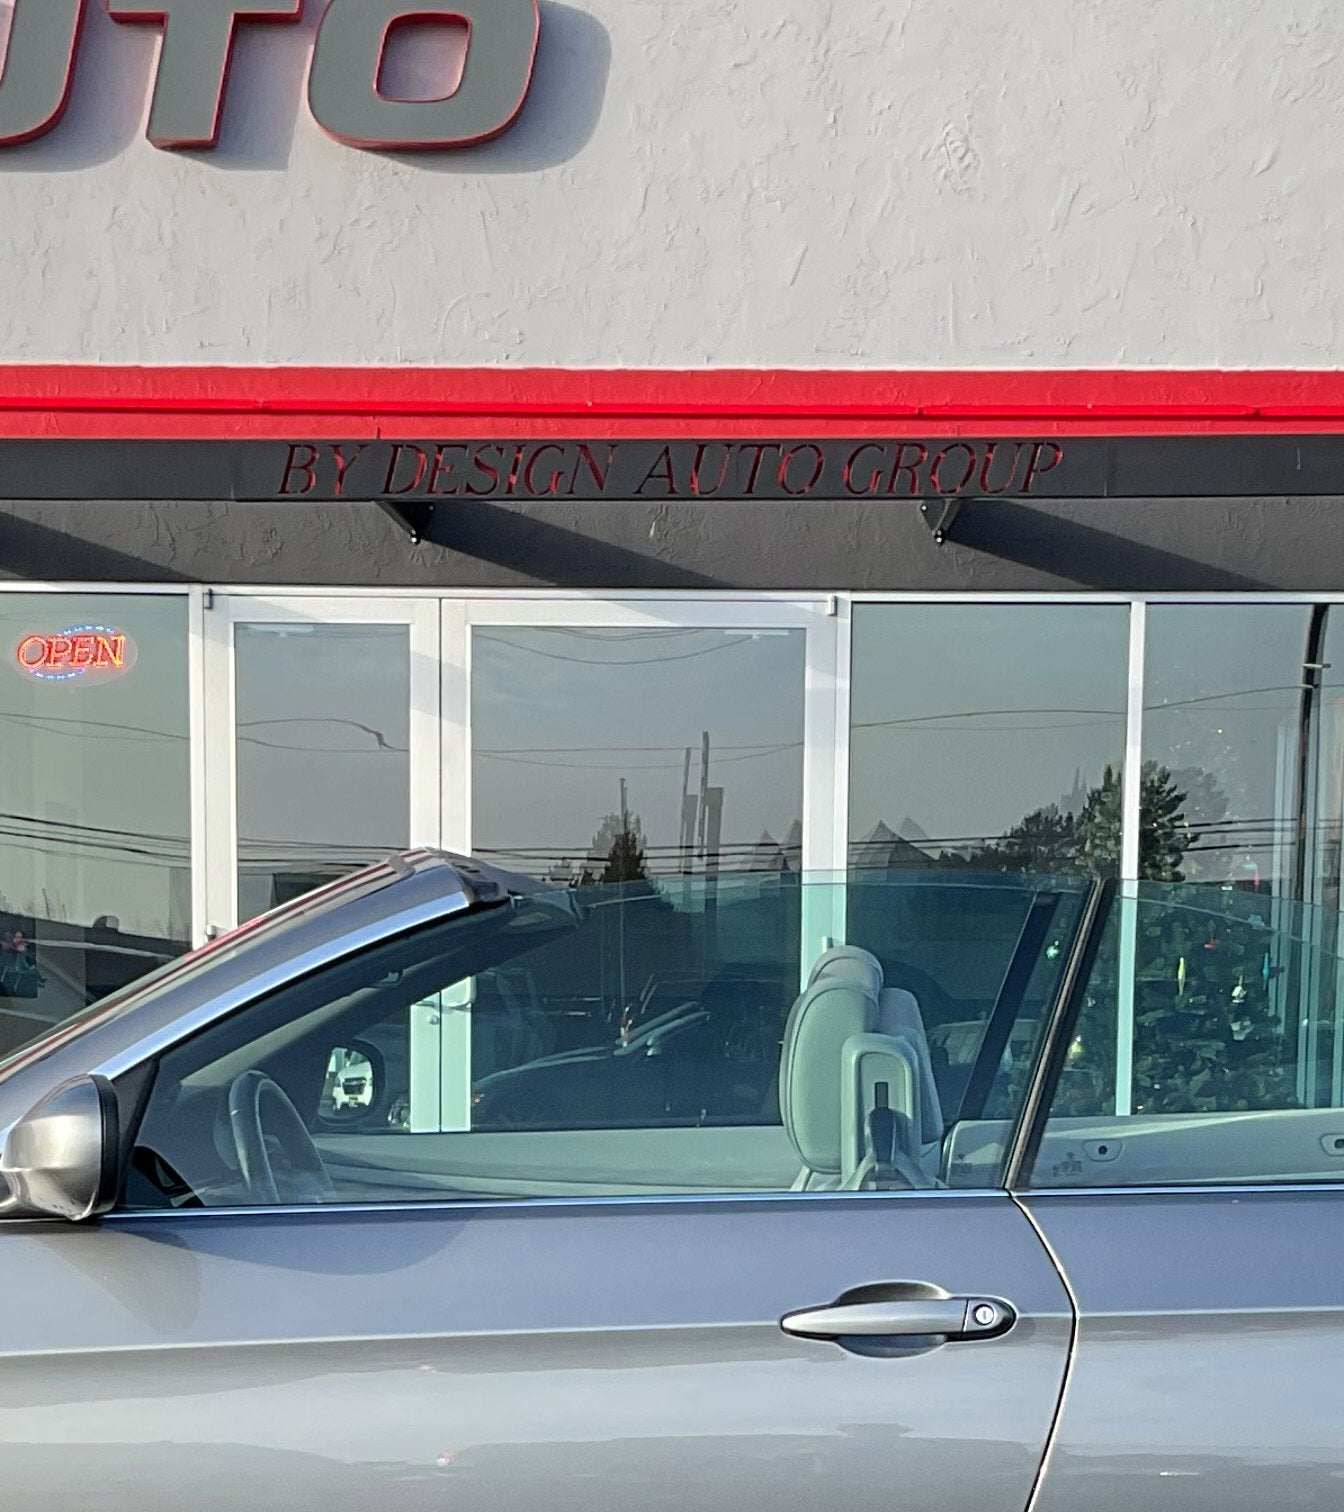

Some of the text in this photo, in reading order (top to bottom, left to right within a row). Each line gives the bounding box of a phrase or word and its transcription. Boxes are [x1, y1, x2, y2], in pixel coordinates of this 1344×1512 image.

[277, 442, 1065, 497] BY DESIGN AUTO GROUP
[17, 634, 126, 669] OPEN
